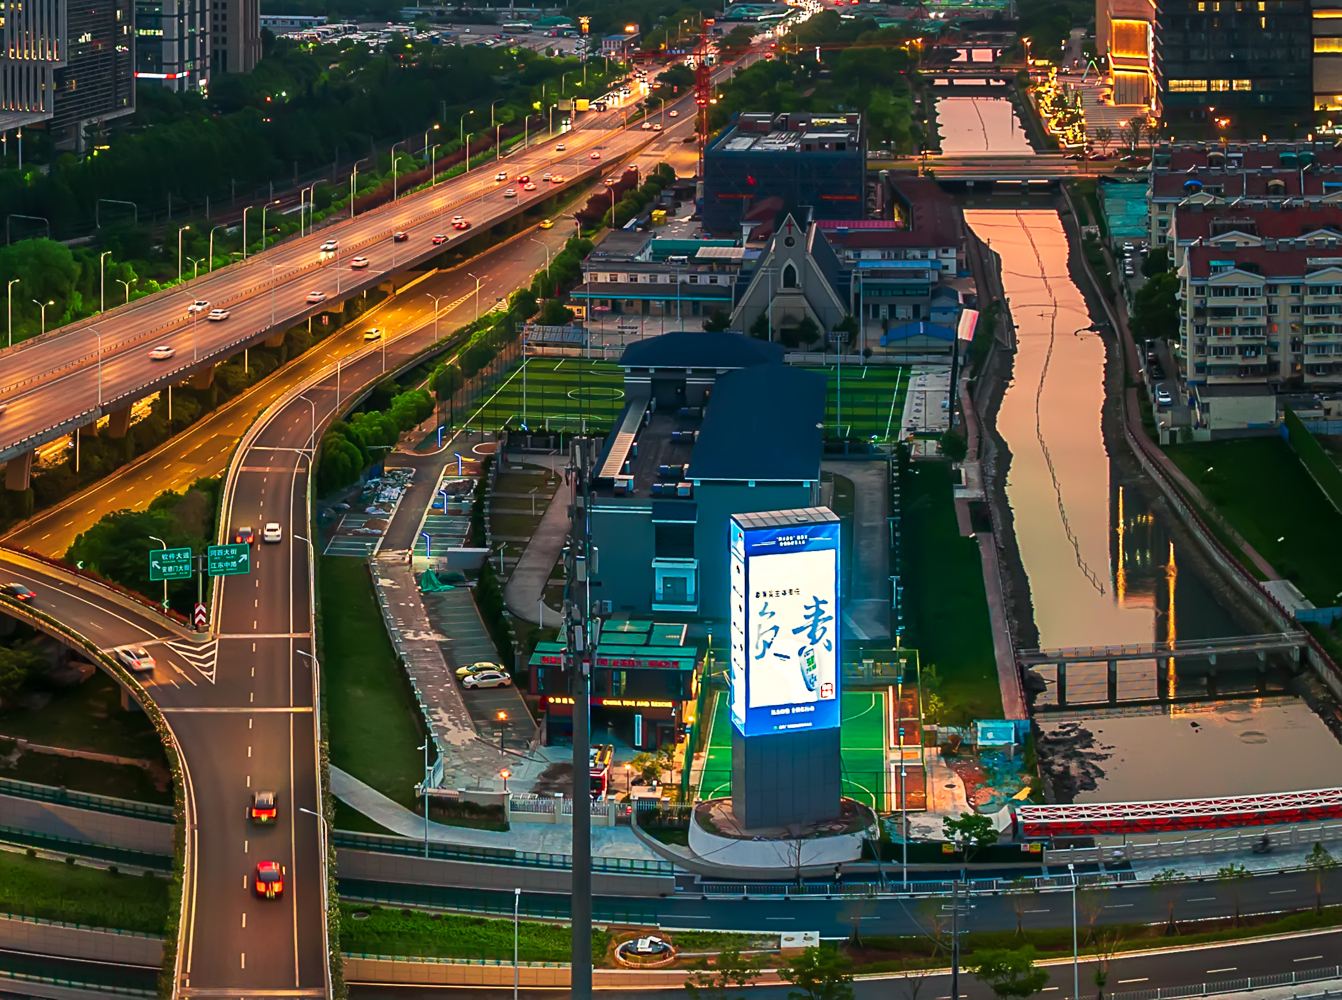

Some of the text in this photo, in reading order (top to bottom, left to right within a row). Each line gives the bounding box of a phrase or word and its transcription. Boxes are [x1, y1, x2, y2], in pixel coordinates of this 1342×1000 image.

[161, 552, 190, 560] 软件大道
[210, 561, 237, 569] 江东中路
